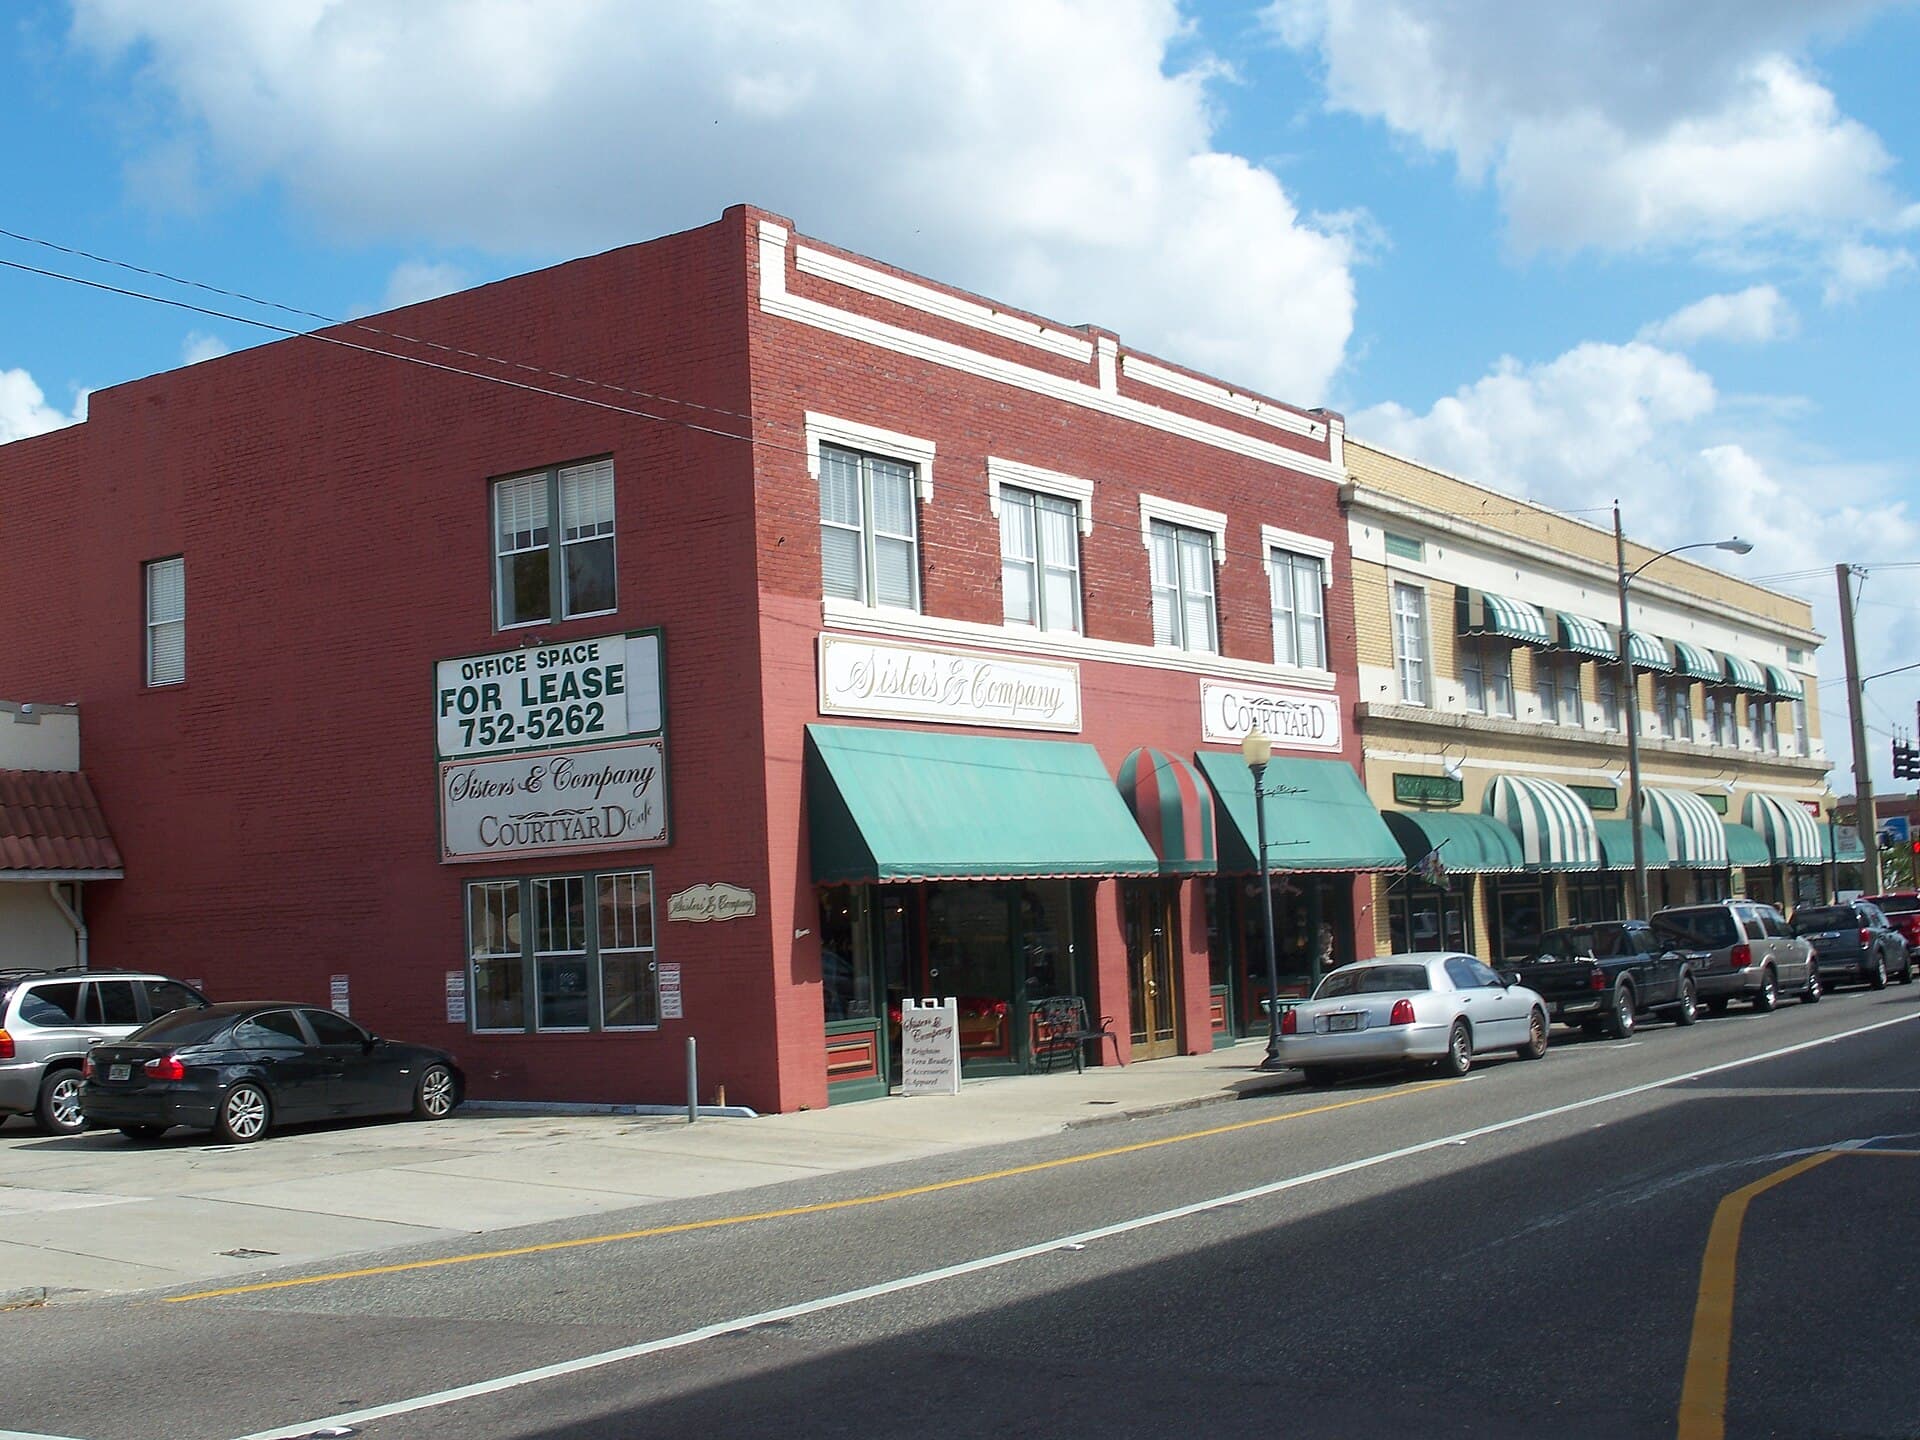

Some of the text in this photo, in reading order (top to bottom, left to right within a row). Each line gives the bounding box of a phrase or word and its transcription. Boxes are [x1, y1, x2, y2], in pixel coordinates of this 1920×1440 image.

[462, 643, 600, 681] OFFICE SPACE
[440, 663, 625, 717] FOR LEASE
[937, 659, 969, 705] &
[972, 663, 1064, 718] Company
[458, 702, 604, 747] 752-5262
[518, 765, 547, 793] &
[550, 756, 656, 800] Company
[479, 805, 626, 847] COURTYARD
